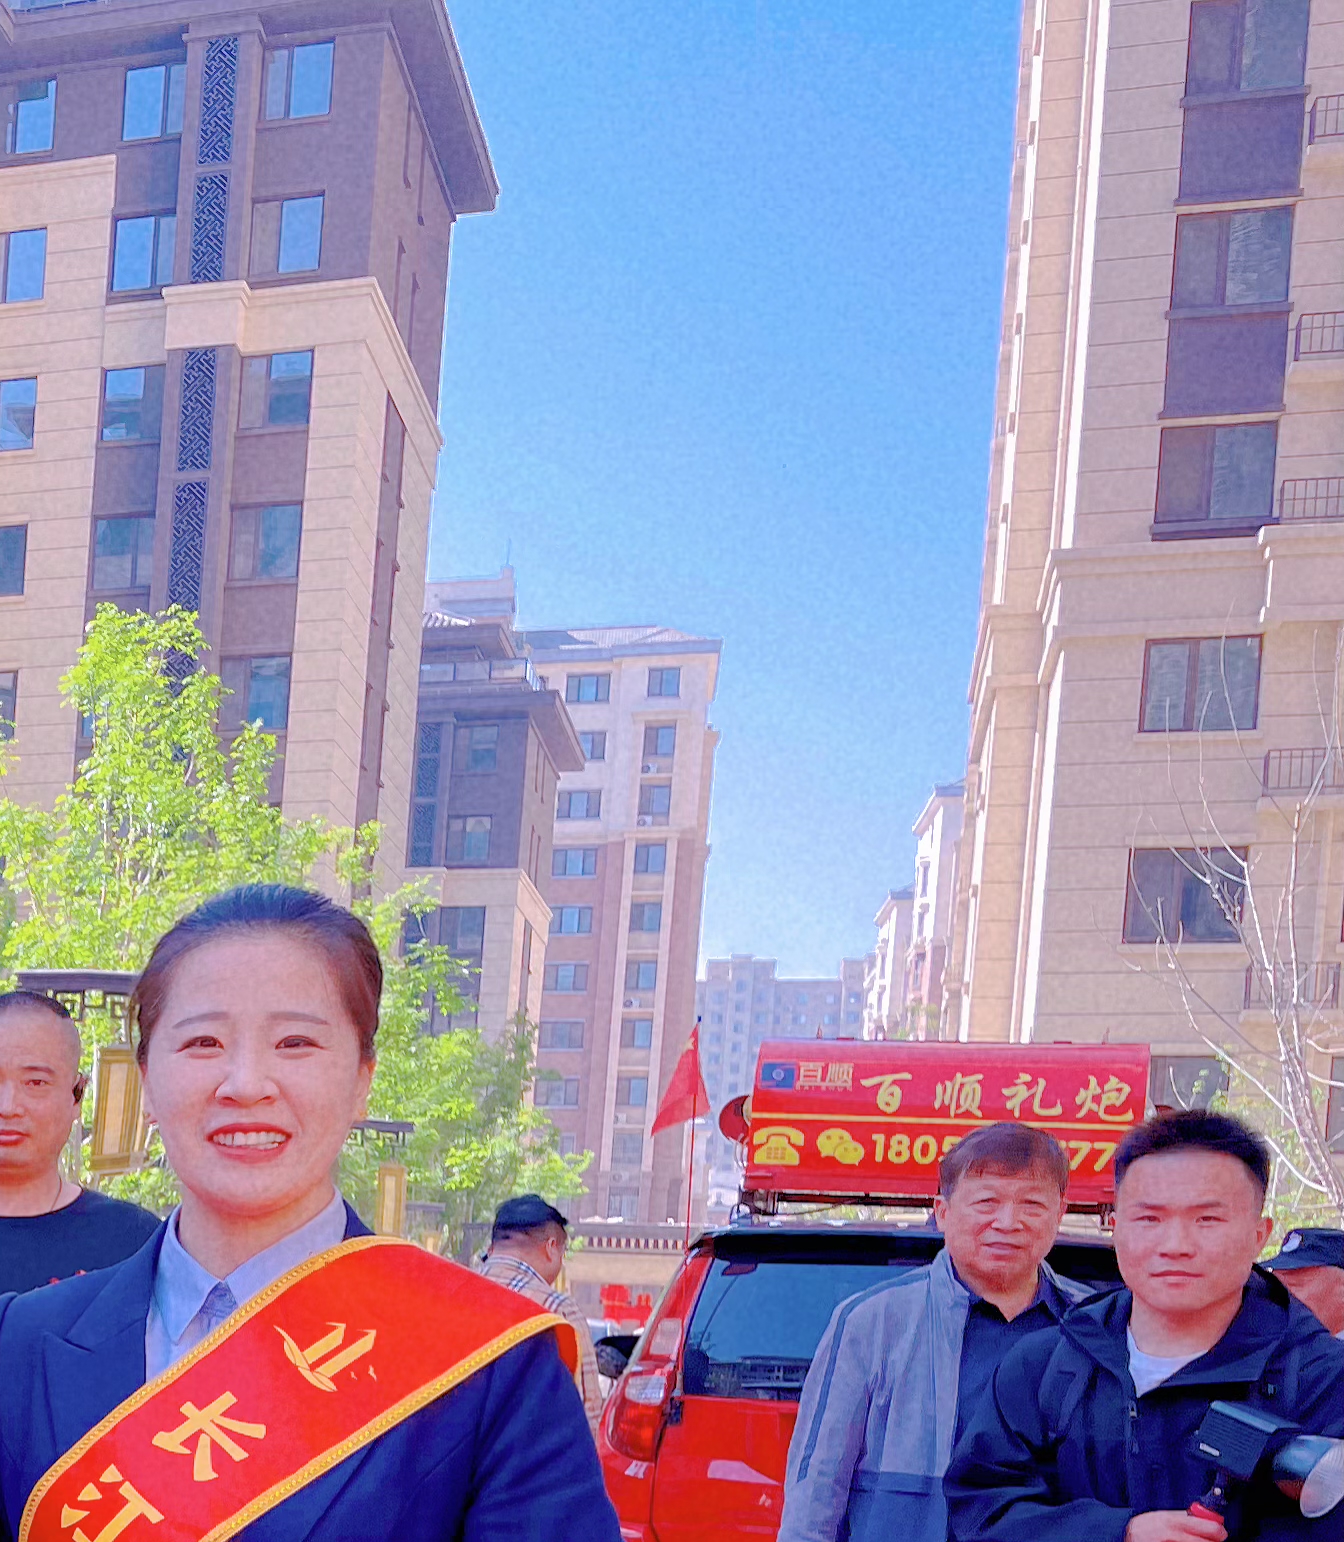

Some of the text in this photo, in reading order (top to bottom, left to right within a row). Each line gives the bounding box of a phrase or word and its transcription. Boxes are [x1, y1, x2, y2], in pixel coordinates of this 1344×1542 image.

[798, 1061, 855, 1084] 百顺
[859, 1071, 1135, 1122] 百顺礼炮
